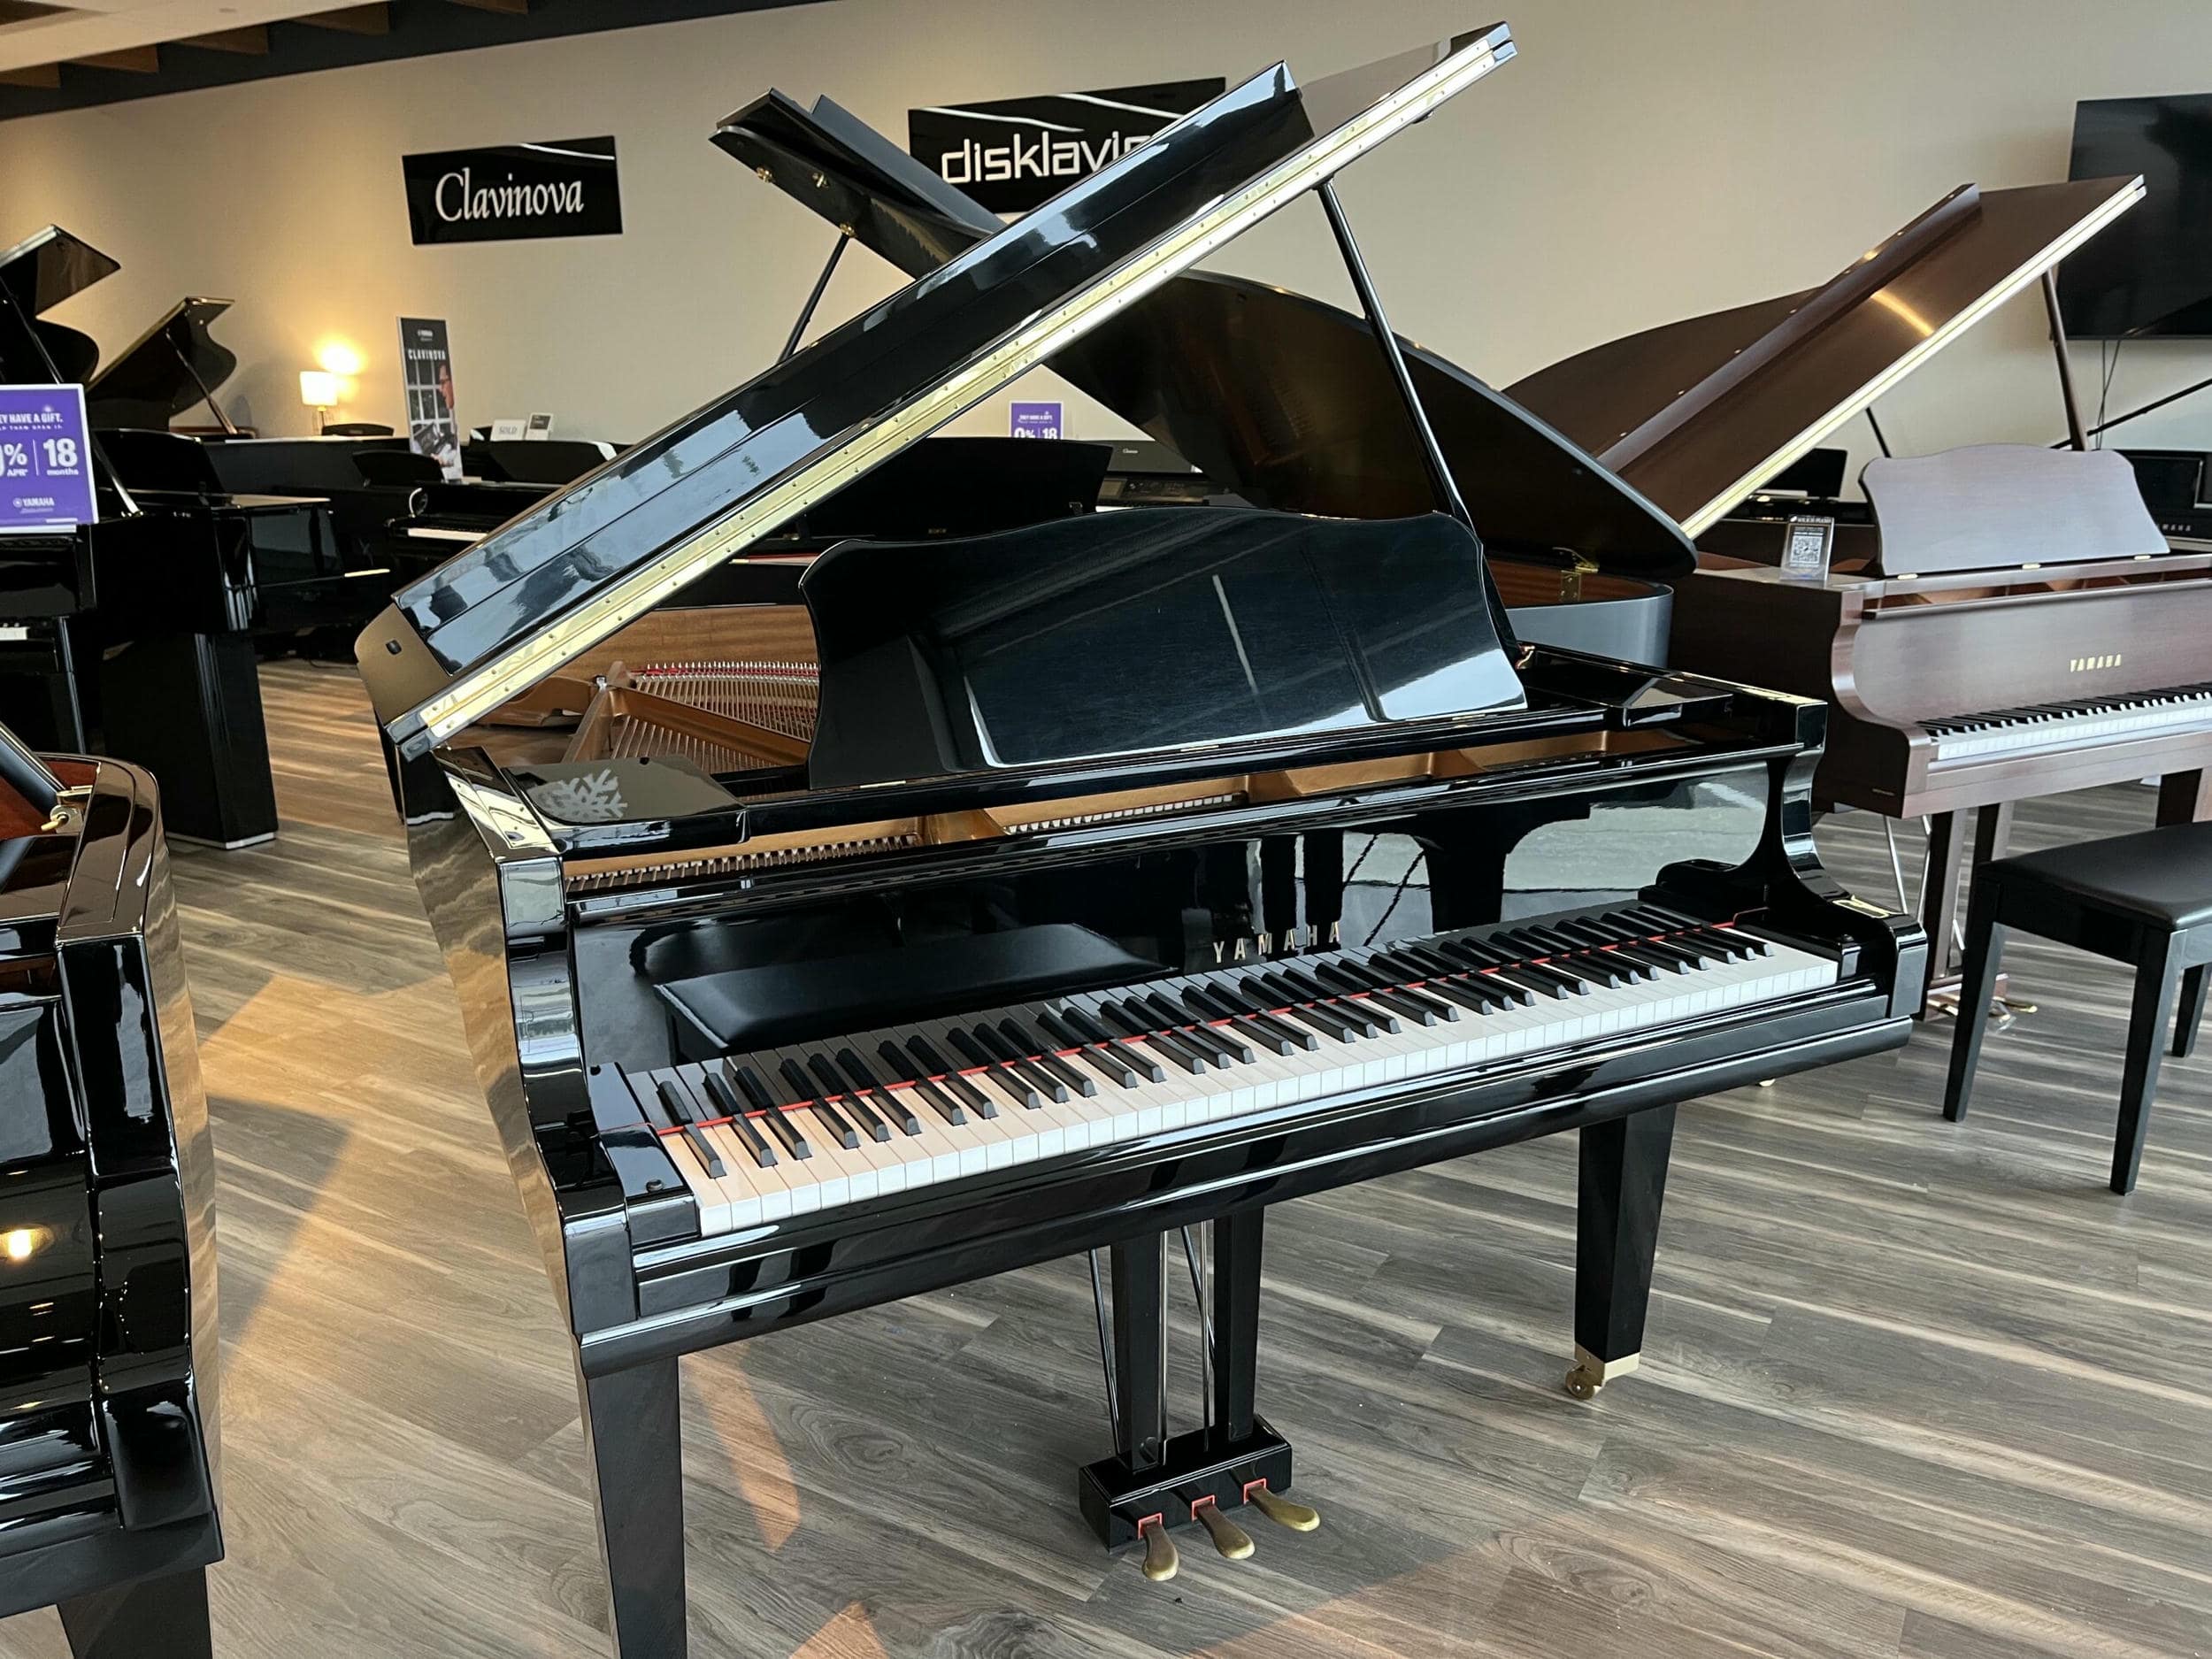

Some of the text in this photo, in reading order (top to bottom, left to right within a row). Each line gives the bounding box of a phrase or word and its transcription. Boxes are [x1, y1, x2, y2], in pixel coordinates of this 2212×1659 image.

[435, 166, 585, 222] Clavinova
[9, 413, 32, 424] HAVE
[34, 412, 41, 423] A
[42, 437, 78, 467] 18
[22, 497, 55, 507] YAMAHA
[2070, 654, 2122, 672] YAMAHA
[1213, 921, 1340, 964] YAMAHA
